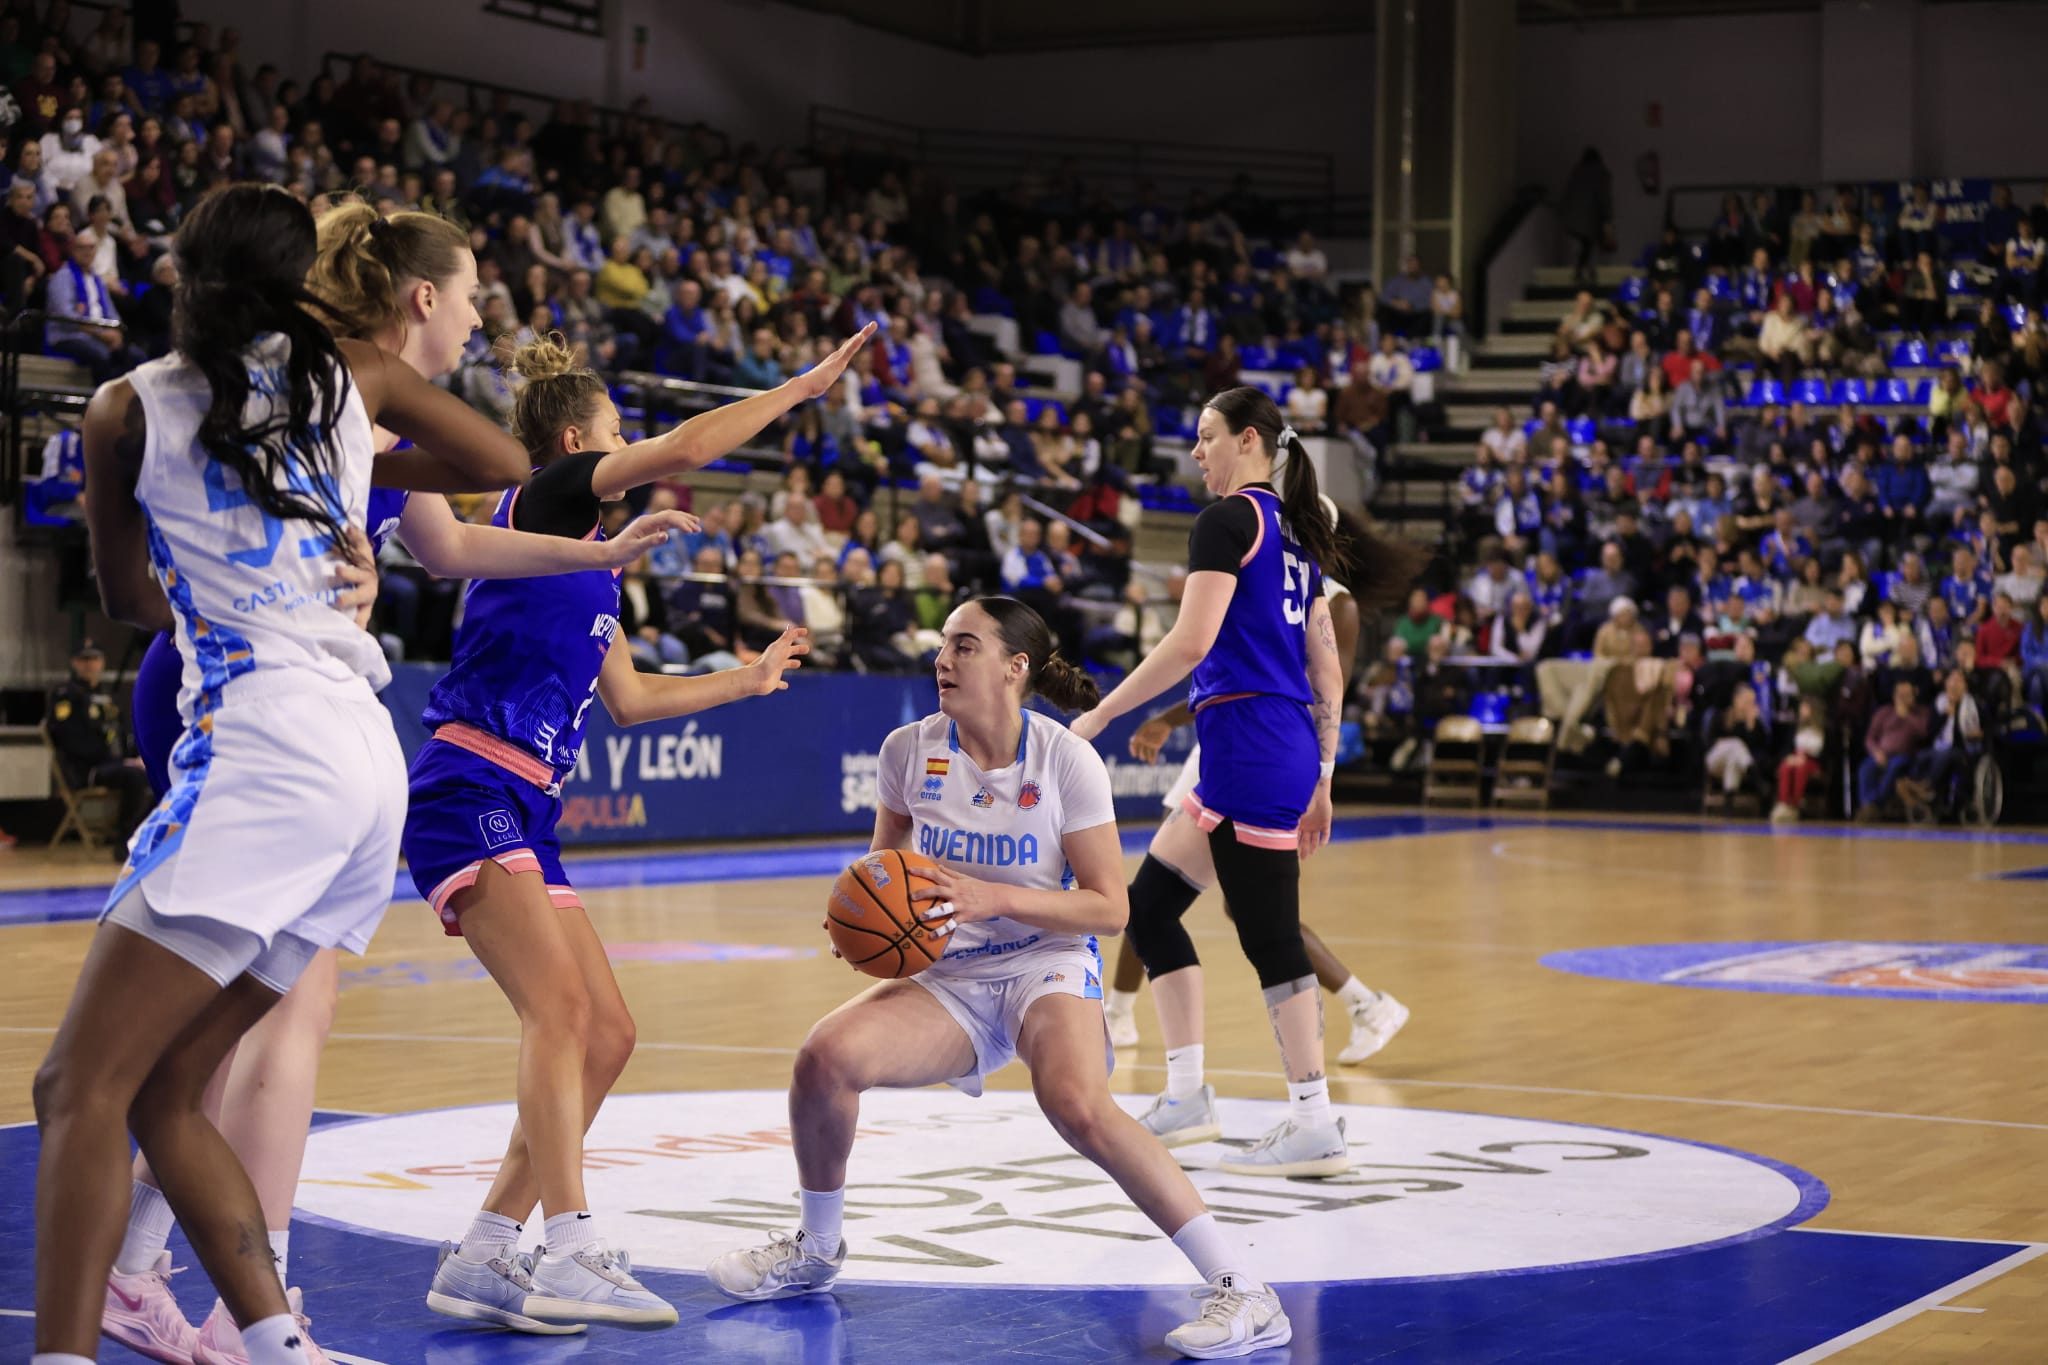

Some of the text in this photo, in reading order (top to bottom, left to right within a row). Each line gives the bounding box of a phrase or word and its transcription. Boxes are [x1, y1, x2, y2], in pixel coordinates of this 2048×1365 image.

[606, 735, 632, 791] Y
[639, 720, 722, 780] LEÓN
[920, 791, 942, 801] errea
[920, 823, 1038, 866] AVENIDA
